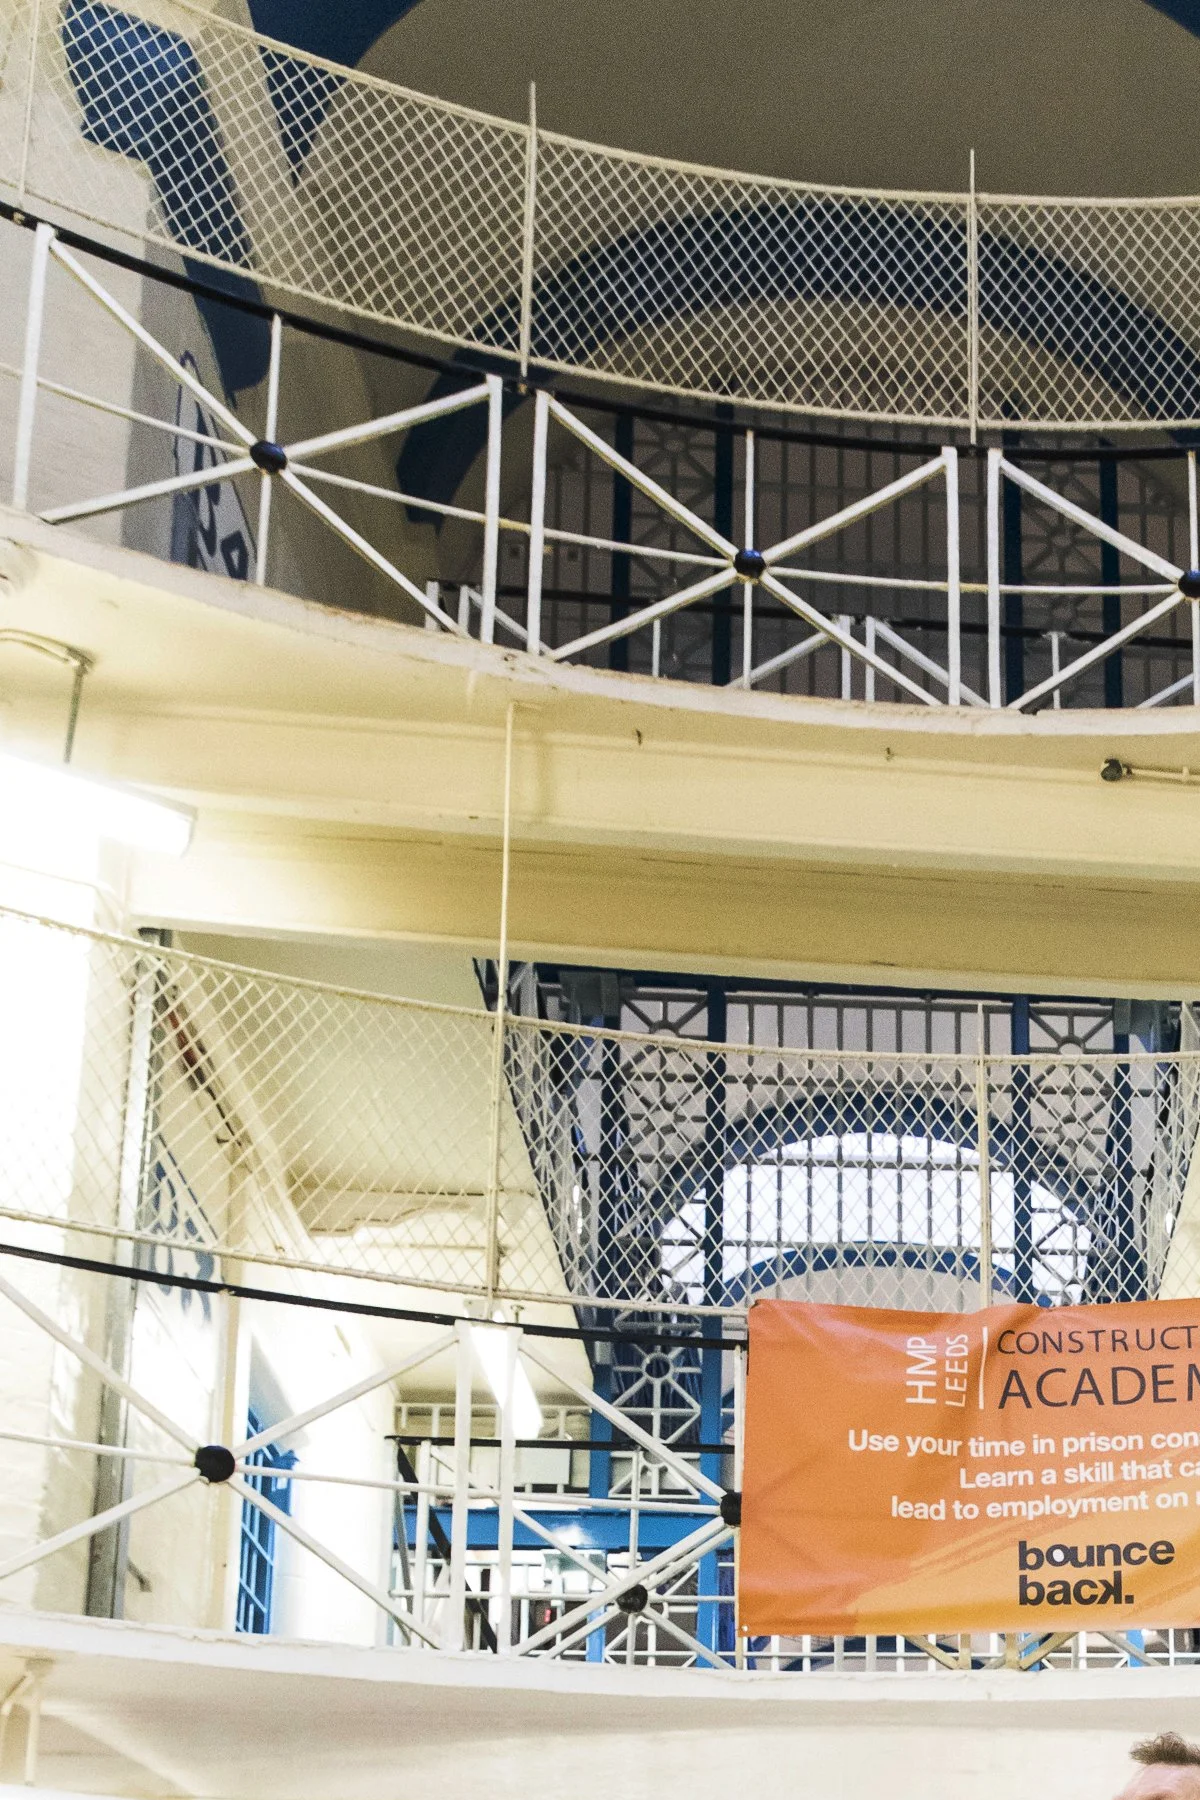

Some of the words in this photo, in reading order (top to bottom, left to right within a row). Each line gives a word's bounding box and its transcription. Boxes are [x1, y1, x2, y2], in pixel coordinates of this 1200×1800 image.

[906, 1336, 938, 1405] HMP
[946, 1334, 968, 1408] LEEDS
[848, 1429, 899, 1451] Use
[906, 1436, 962, 1457] your
[968, 1436, 1026, 1457] time
[1032, 1434, 1055, 1454] in
[1063, 1432, 1143, 1457] prison
[960, 1468, 1034, 1489] Learn
[1041, 1468, 1057, 1485] a
[1064, 1460, 1114, 1483] skill
[1121, 1459, 1172, 1481] that
[892, 1496, 946, 1521] lead
[952, 1500, 979, 1520] to
[986, 1490, 1149, 1521] employment
[1156, 1492, 1188, 1509] on
[1018, 1540, 1175, 1571] bounce
[1018, 1570, 1134, 1605] back.
